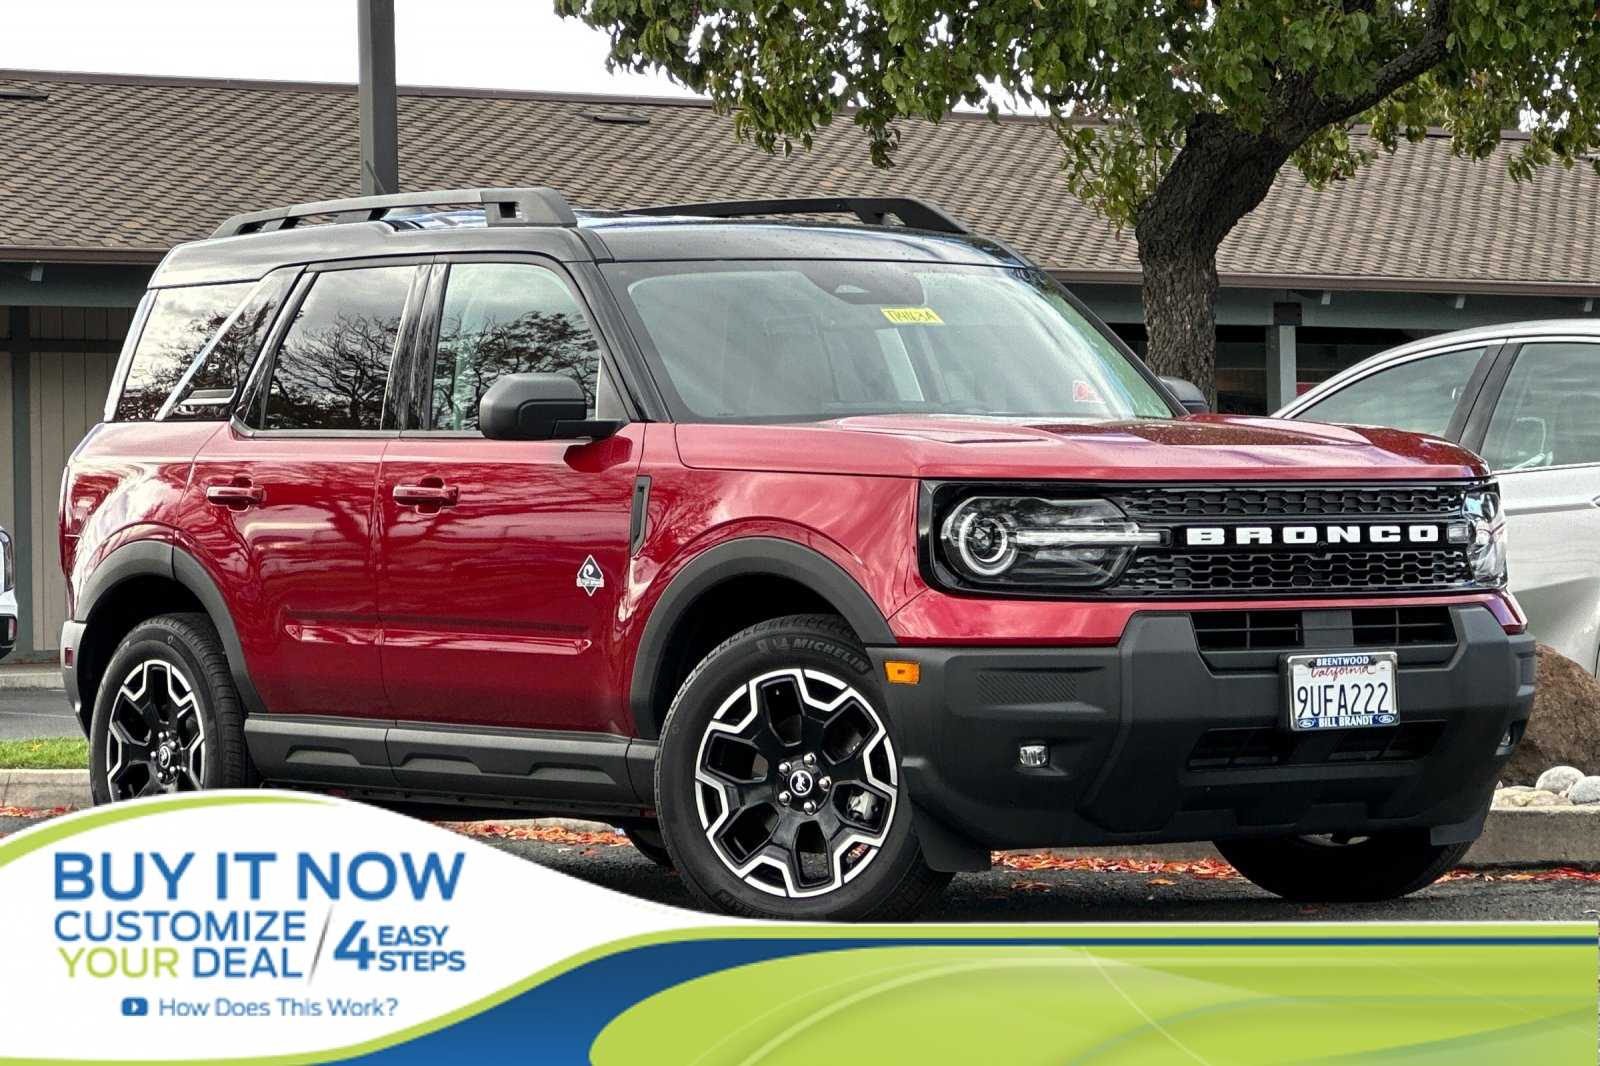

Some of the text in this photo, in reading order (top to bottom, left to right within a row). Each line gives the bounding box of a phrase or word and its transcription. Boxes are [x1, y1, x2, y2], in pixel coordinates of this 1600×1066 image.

[1186, 525, 1439, 546] BRONCO
[793, 638, 870, 673] MICHELIN
[1316, 656, 1370, 667] BRENTWOOD
[1297, 682, 1389, 718] 9UFA222
[1318, 717, 1337, 728] BILL
[1339, 715, 1374, 727] BRANDT
